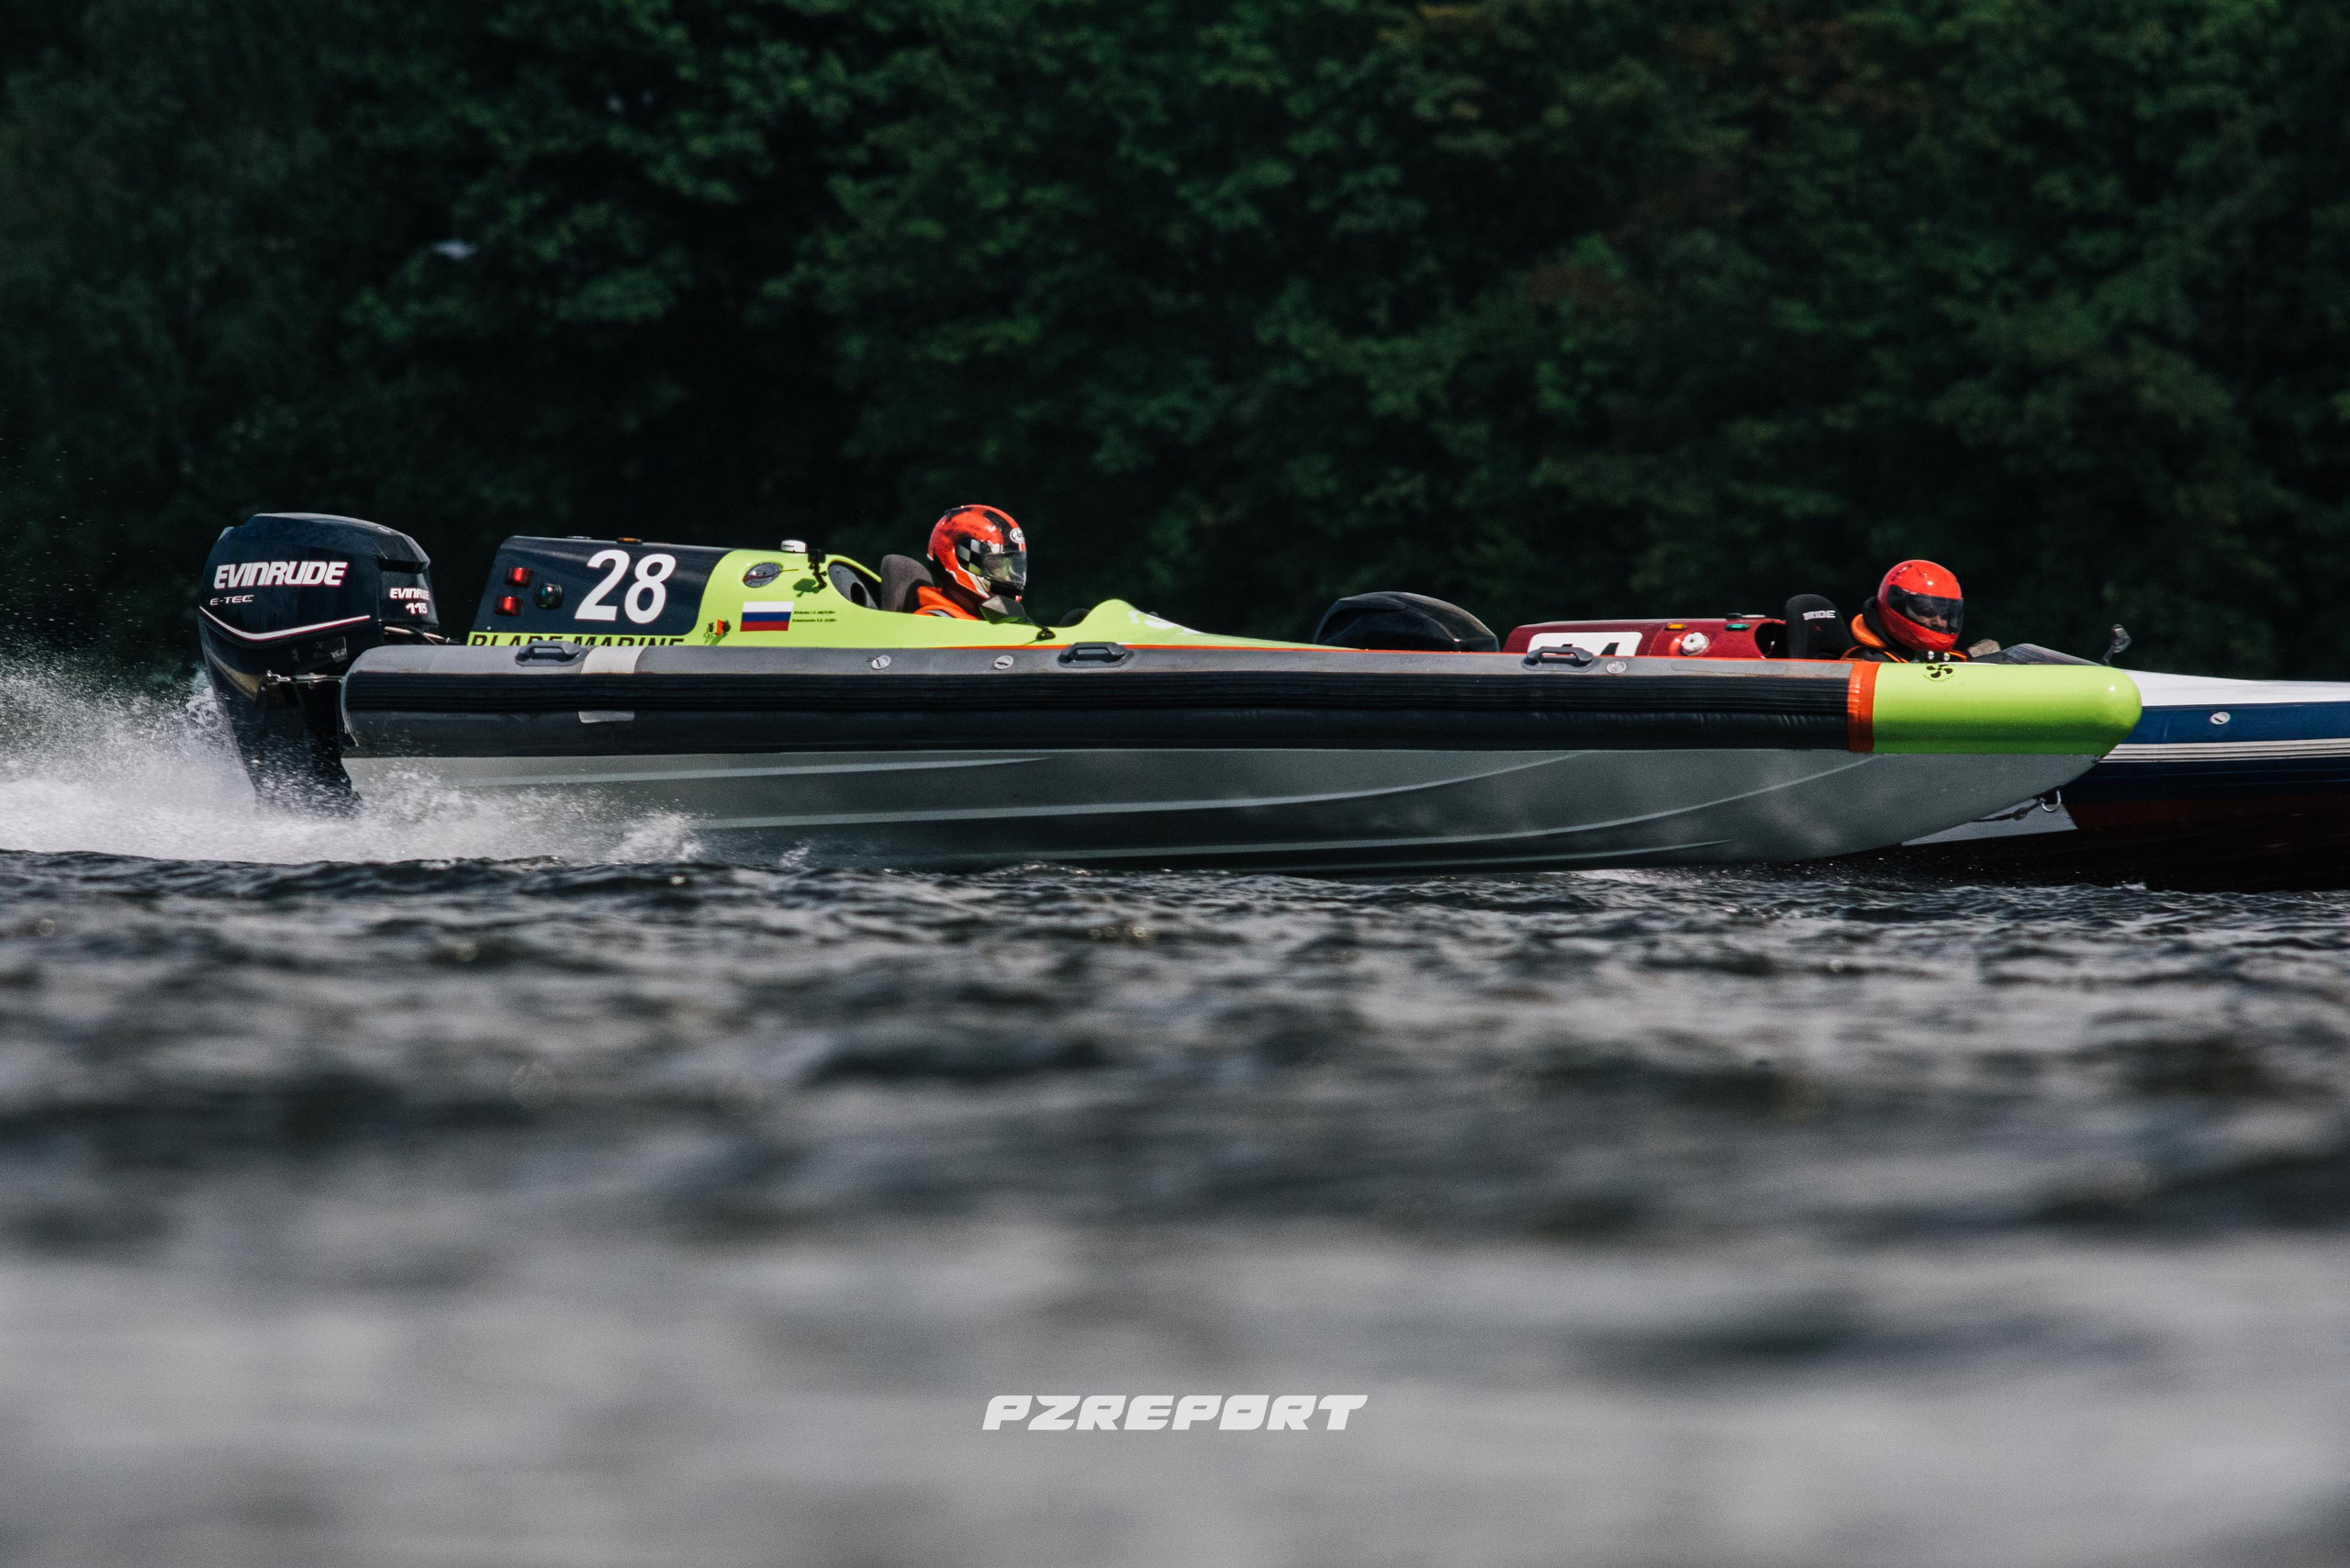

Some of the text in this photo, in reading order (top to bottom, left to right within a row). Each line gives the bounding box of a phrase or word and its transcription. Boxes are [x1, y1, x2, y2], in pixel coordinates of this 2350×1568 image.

[213, 560, 349, 589] EVINRUDE
[574, 549, 677, 624] 28
[209, 594, 255, 606] E-TEC
